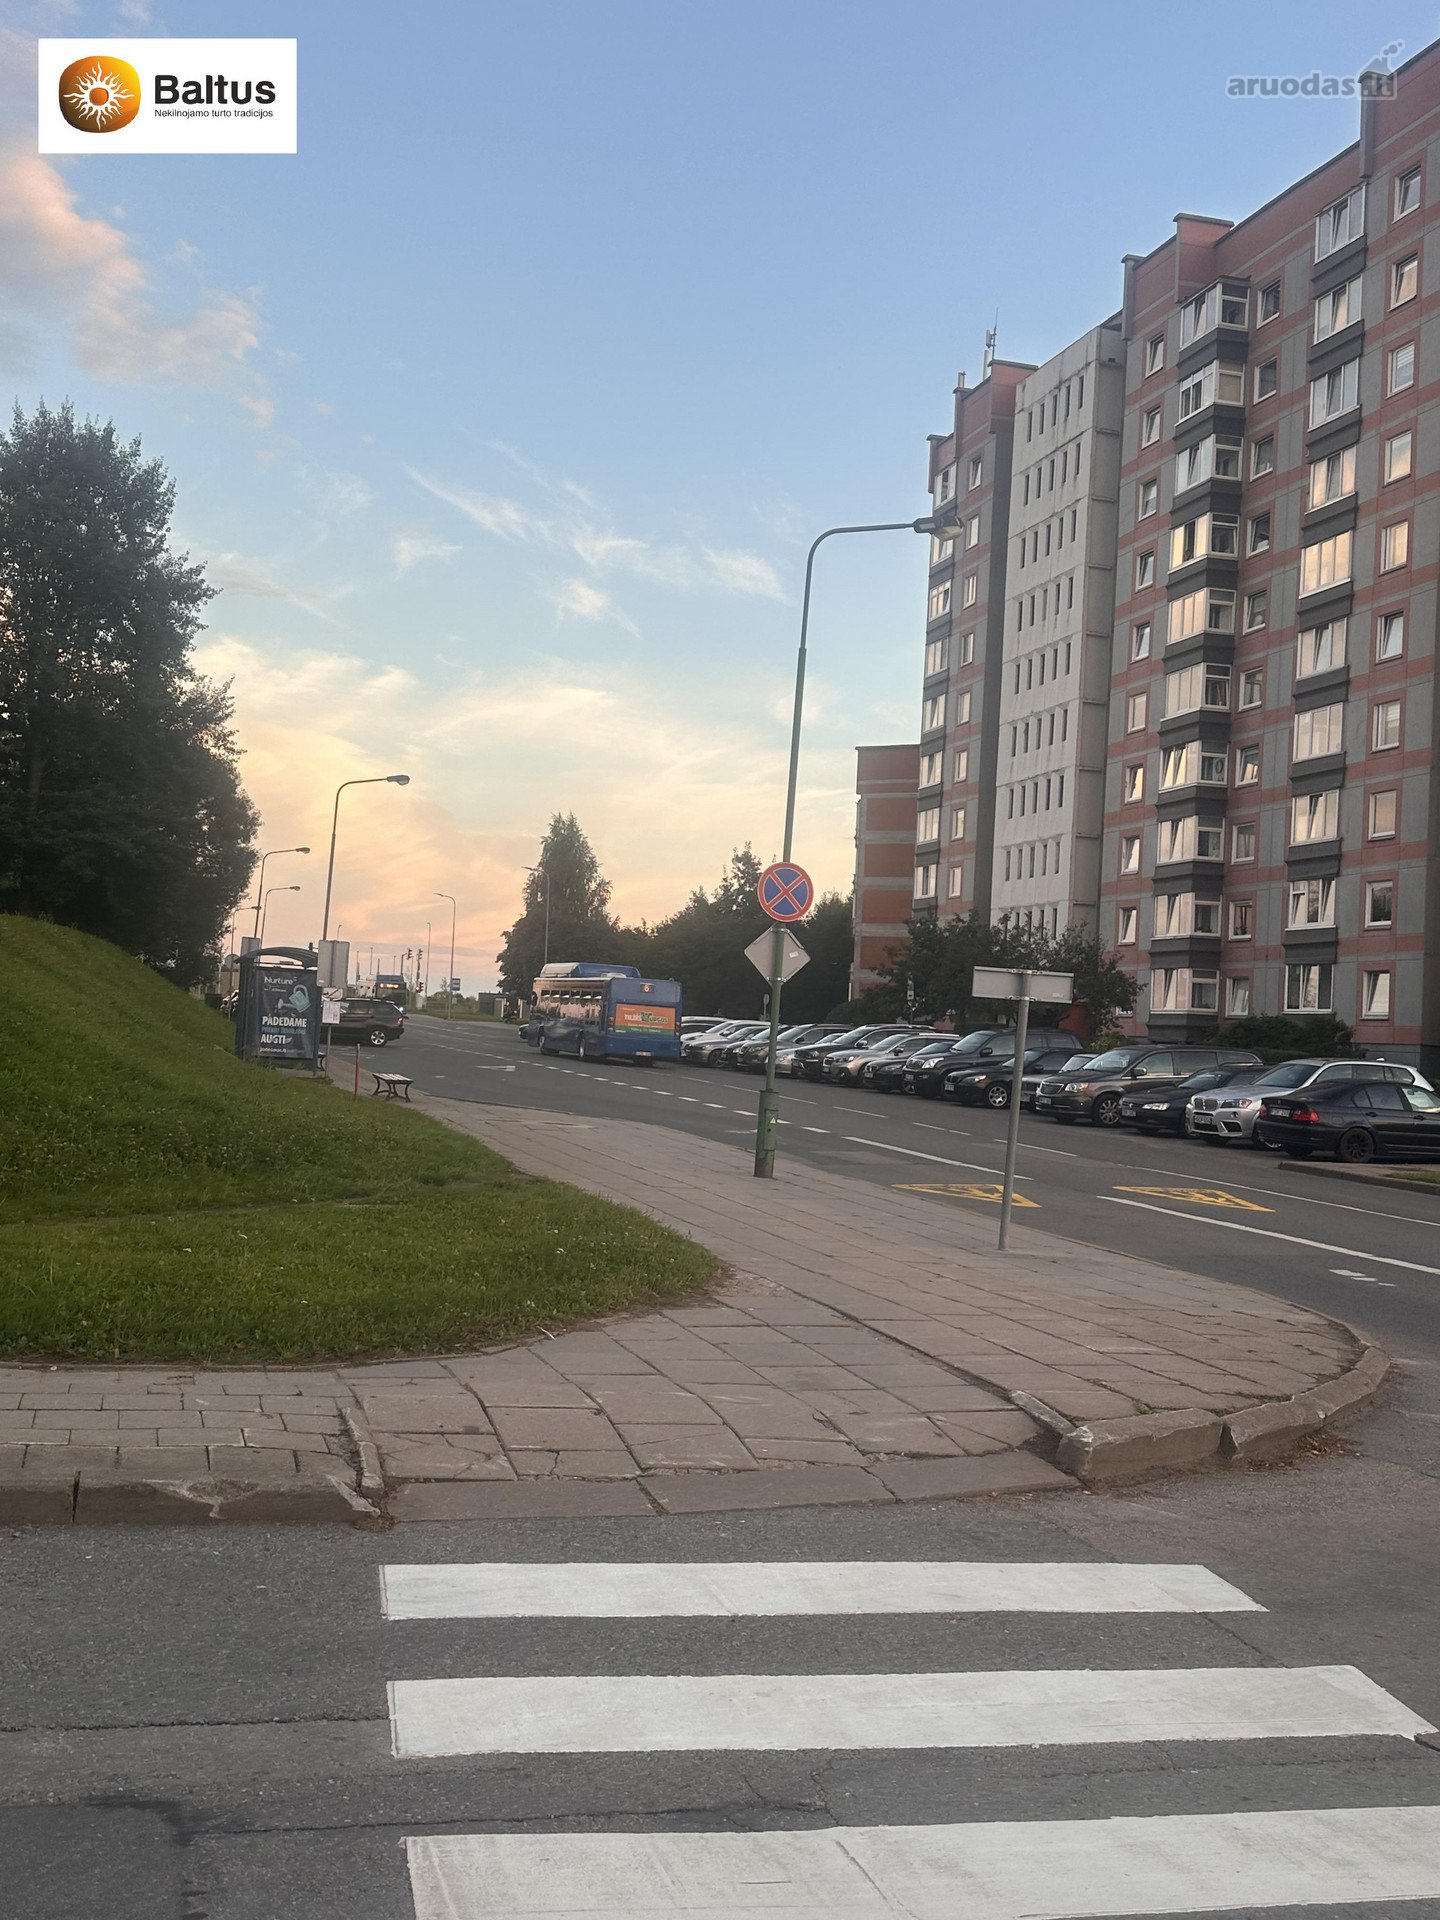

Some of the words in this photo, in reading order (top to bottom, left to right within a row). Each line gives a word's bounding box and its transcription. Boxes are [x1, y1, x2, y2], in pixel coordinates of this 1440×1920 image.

[264, 976, 294, 985] Nurture
[262, 1015, 307, 1028] PADEDAME
[260, 1033, 286, 1044] AUGTI
